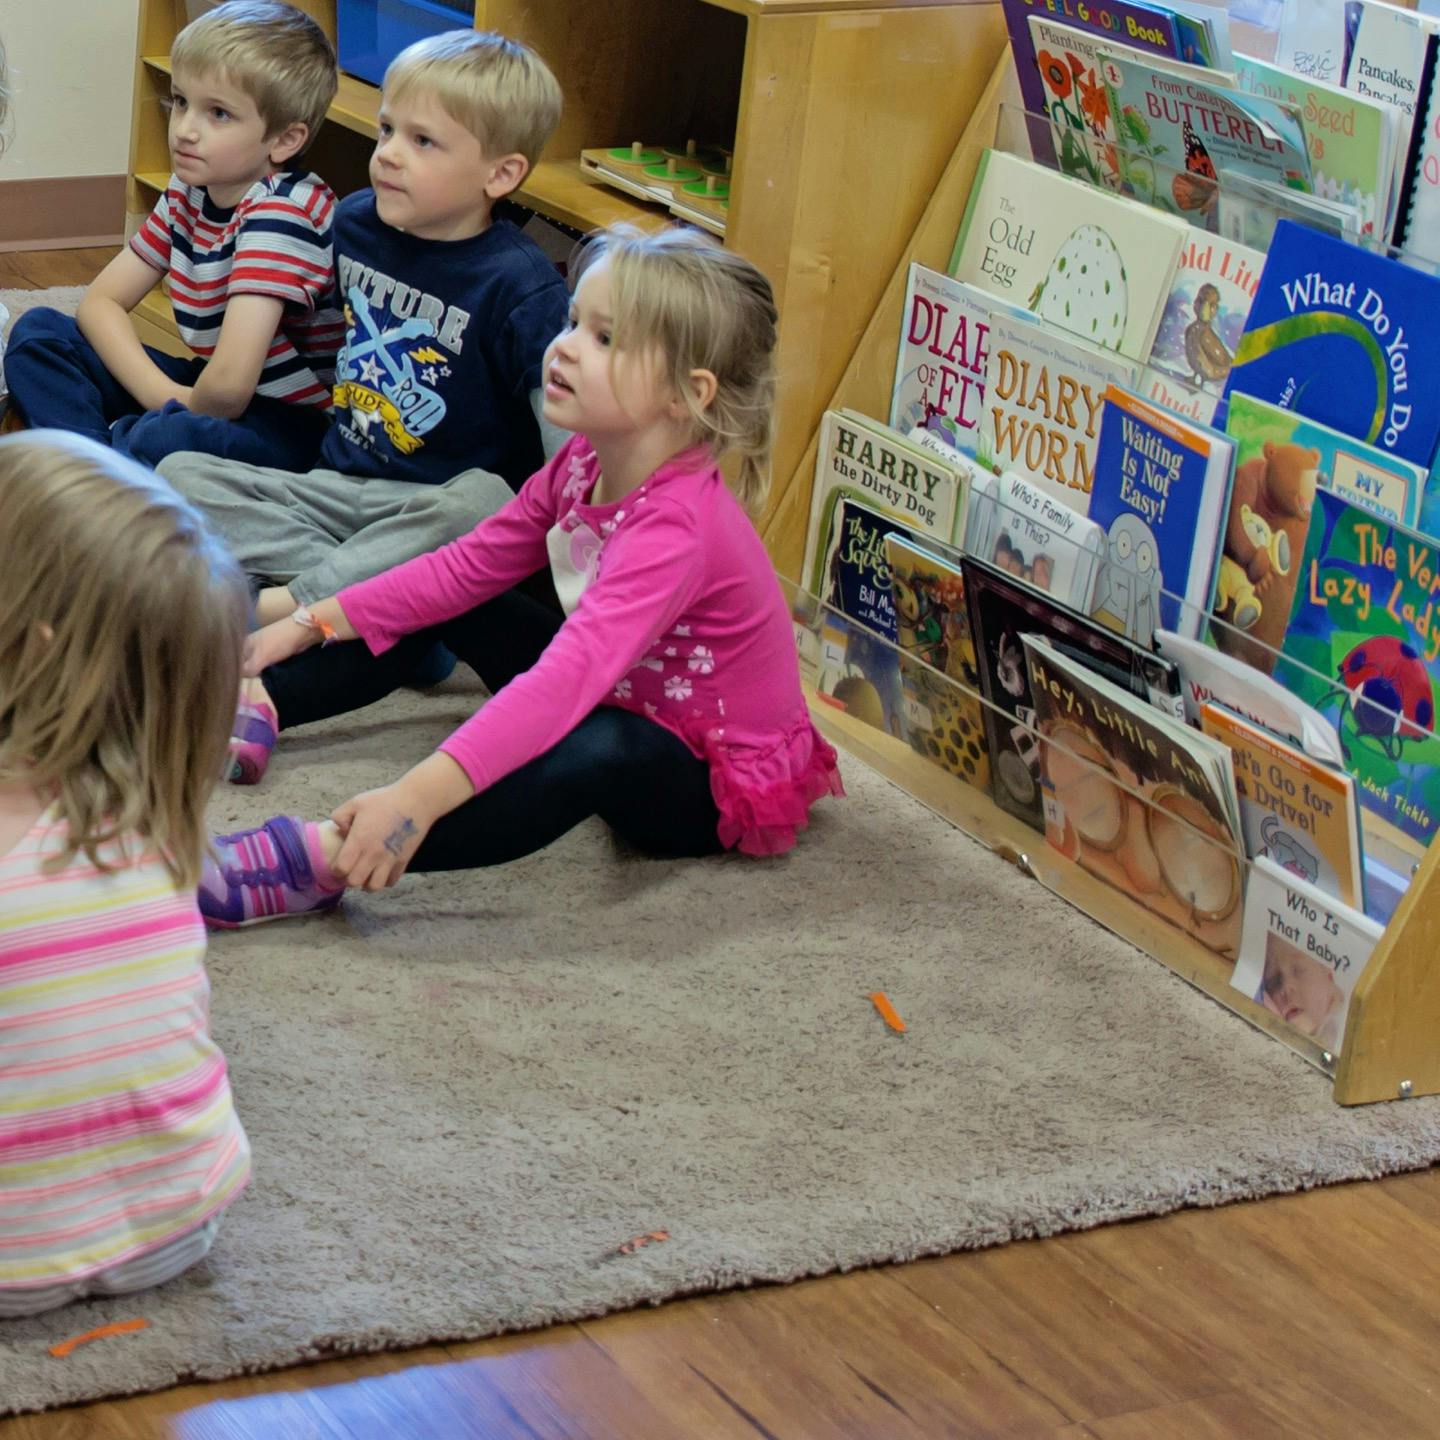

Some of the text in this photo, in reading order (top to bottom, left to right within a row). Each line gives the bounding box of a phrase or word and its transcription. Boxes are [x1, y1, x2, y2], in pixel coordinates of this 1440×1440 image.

[1038, 24, 1097, 56] Planting
[1077, 1, 1121, 33] GOOD
[1124, 15, 1168, 47] Book
[1152, 74, 1182, 96] From
[1358, 56, 1416, 94] Pancakes,
[1303, 88, 1357, 138] Seed
[998, 196, 1017, 216] The
[989, 216, 1037, 257] Odd
[979, 245, 1018, 289] Egg
[1280, 271, 1357, 314] What
[1356, 287, 1391, 336] Do
[917, 363, 938, 388] OF
[1384, 325, 1409, 395] You
[392, 376, 442, 433] ROLL
[918, 387, 930, 409] A
[995, 349, 1106, 439] DIARY
[1121, 416, 1184, 481] Waiting
[1382, 403, 1413, 449] Do
[837, 426, 941, 503] HARRY
[1121, 448, 1172, 498] Is Not
[1354, 468, 1385, 499] MY
[832, 456, 937, 528] the Dirty Dog
[1009, 479, 1075, 533] Who's Family
[1121, 476, 1167, 525] Easy!
[845, 517, 871, 544] The
[1023, 518, 1051, 546] This?
[1353, 522, 1397, 572] The
[858, 584, 876, 605] Bill
[1309, 559, 1372, 621] Lazy
[1030, 662, 1084, 717] Hey,
[1091, 697, 1159, 759] Little
[1169, 749, 1212, 795] Ant
[1254, 780, 1317, 836] Drive!
[1269, 762, 1334, 818] Go for
[1361, 774, 1390, 803] Jack
[1393, 794, 1431, 829] Tickle
[1286, 887, 1340, 937] Who Is
[1267, 907, 1352, 973] That Baby?
